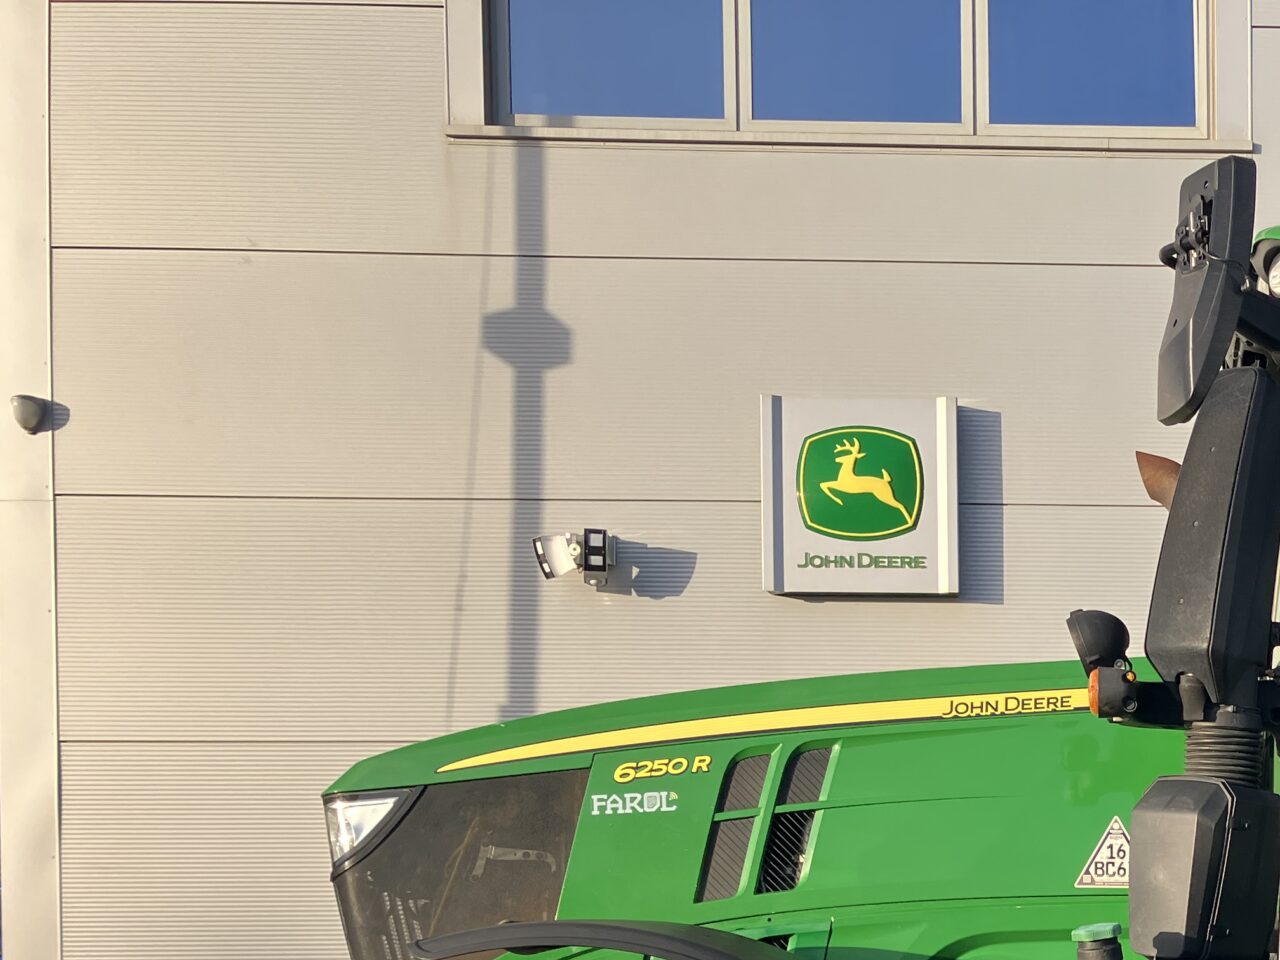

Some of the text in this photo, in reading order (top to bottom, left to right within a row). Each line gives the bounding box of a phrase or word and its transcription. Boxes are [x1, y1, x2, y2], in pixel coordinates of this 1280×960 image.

[797, 552, 927, 569] JOHN DEERE
[942, 696, 1072, 717] JOHN DEERE
[591, 791, 677, 815] FAROL
[1106, 843, 1127, 860] 16
